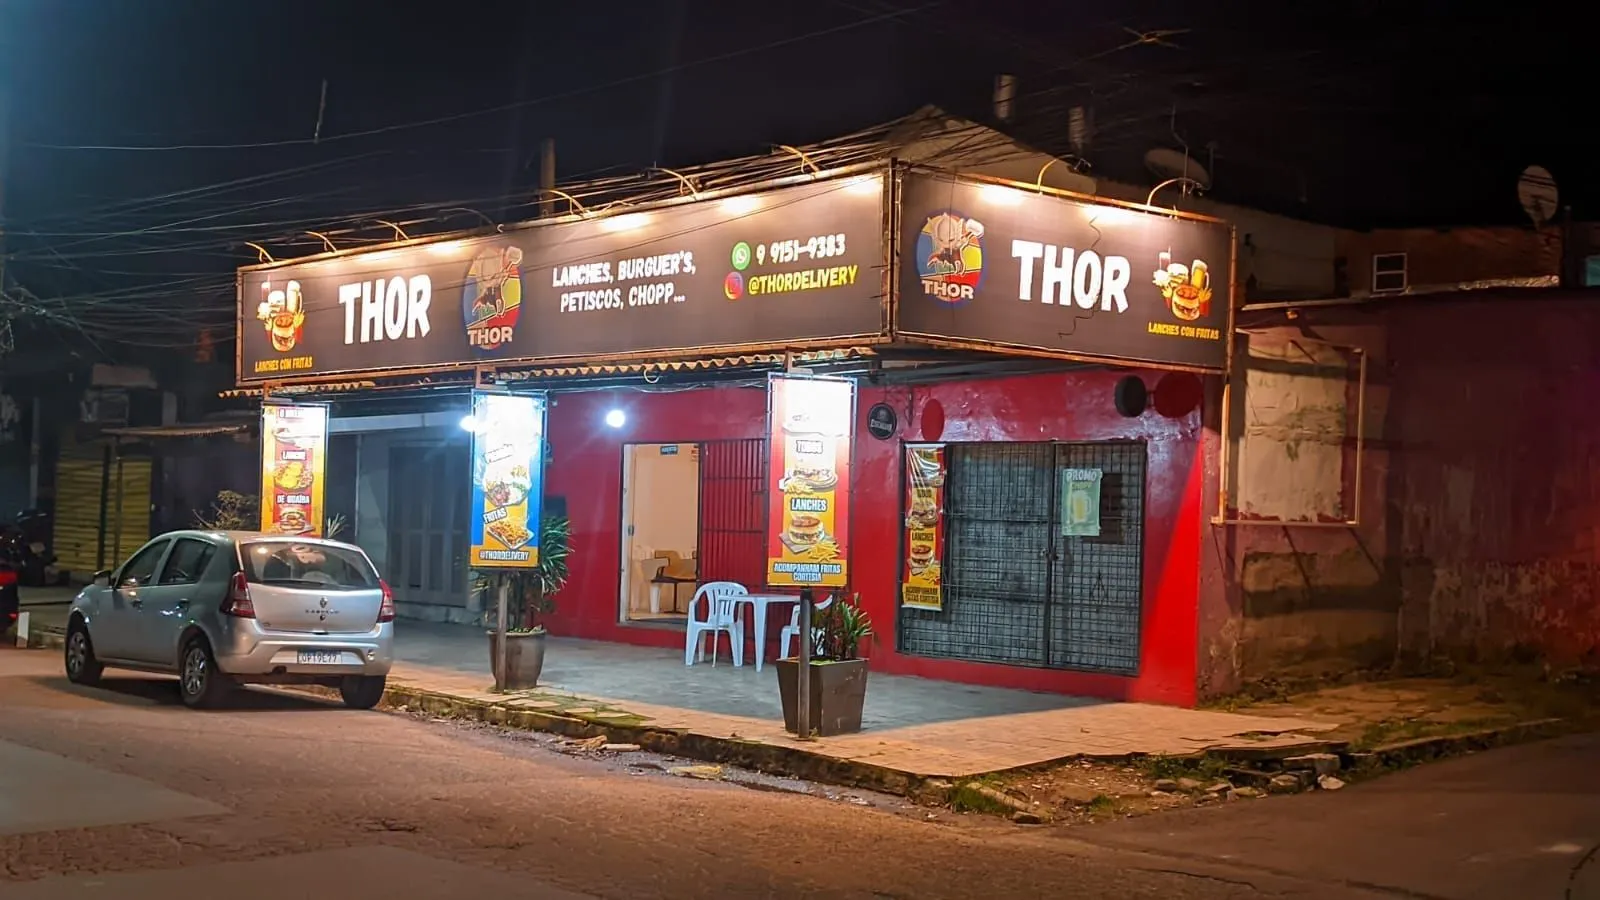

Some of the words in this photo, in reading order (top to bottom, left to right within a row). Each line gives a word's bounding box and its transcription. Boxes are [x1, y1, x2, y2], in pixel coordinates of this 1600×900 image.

[755, 244, 764, 265] 9
[769, 233, 845, 264] 9151-9383
[552, 262, 614, 288] LANCHES,
[617, 249, 697, 281] BURGUER'S,
[748, 264, 858, 296] @THORDELIVERY
[1011, 239, 1131, 314] THOR
[560, 289, 624, 313] PETISCOS,
[628, 281, 686, 306] CHOPP...
[921, 278, 975, 300] THOR
[339, 274, 432, 345] THOR
[467, 326, 513, 346] THOR
[1066, 469, 1097, 481] PROMO
[276, 494, 286, 504] DE
[791, 497, 827, 512] LANCHES
